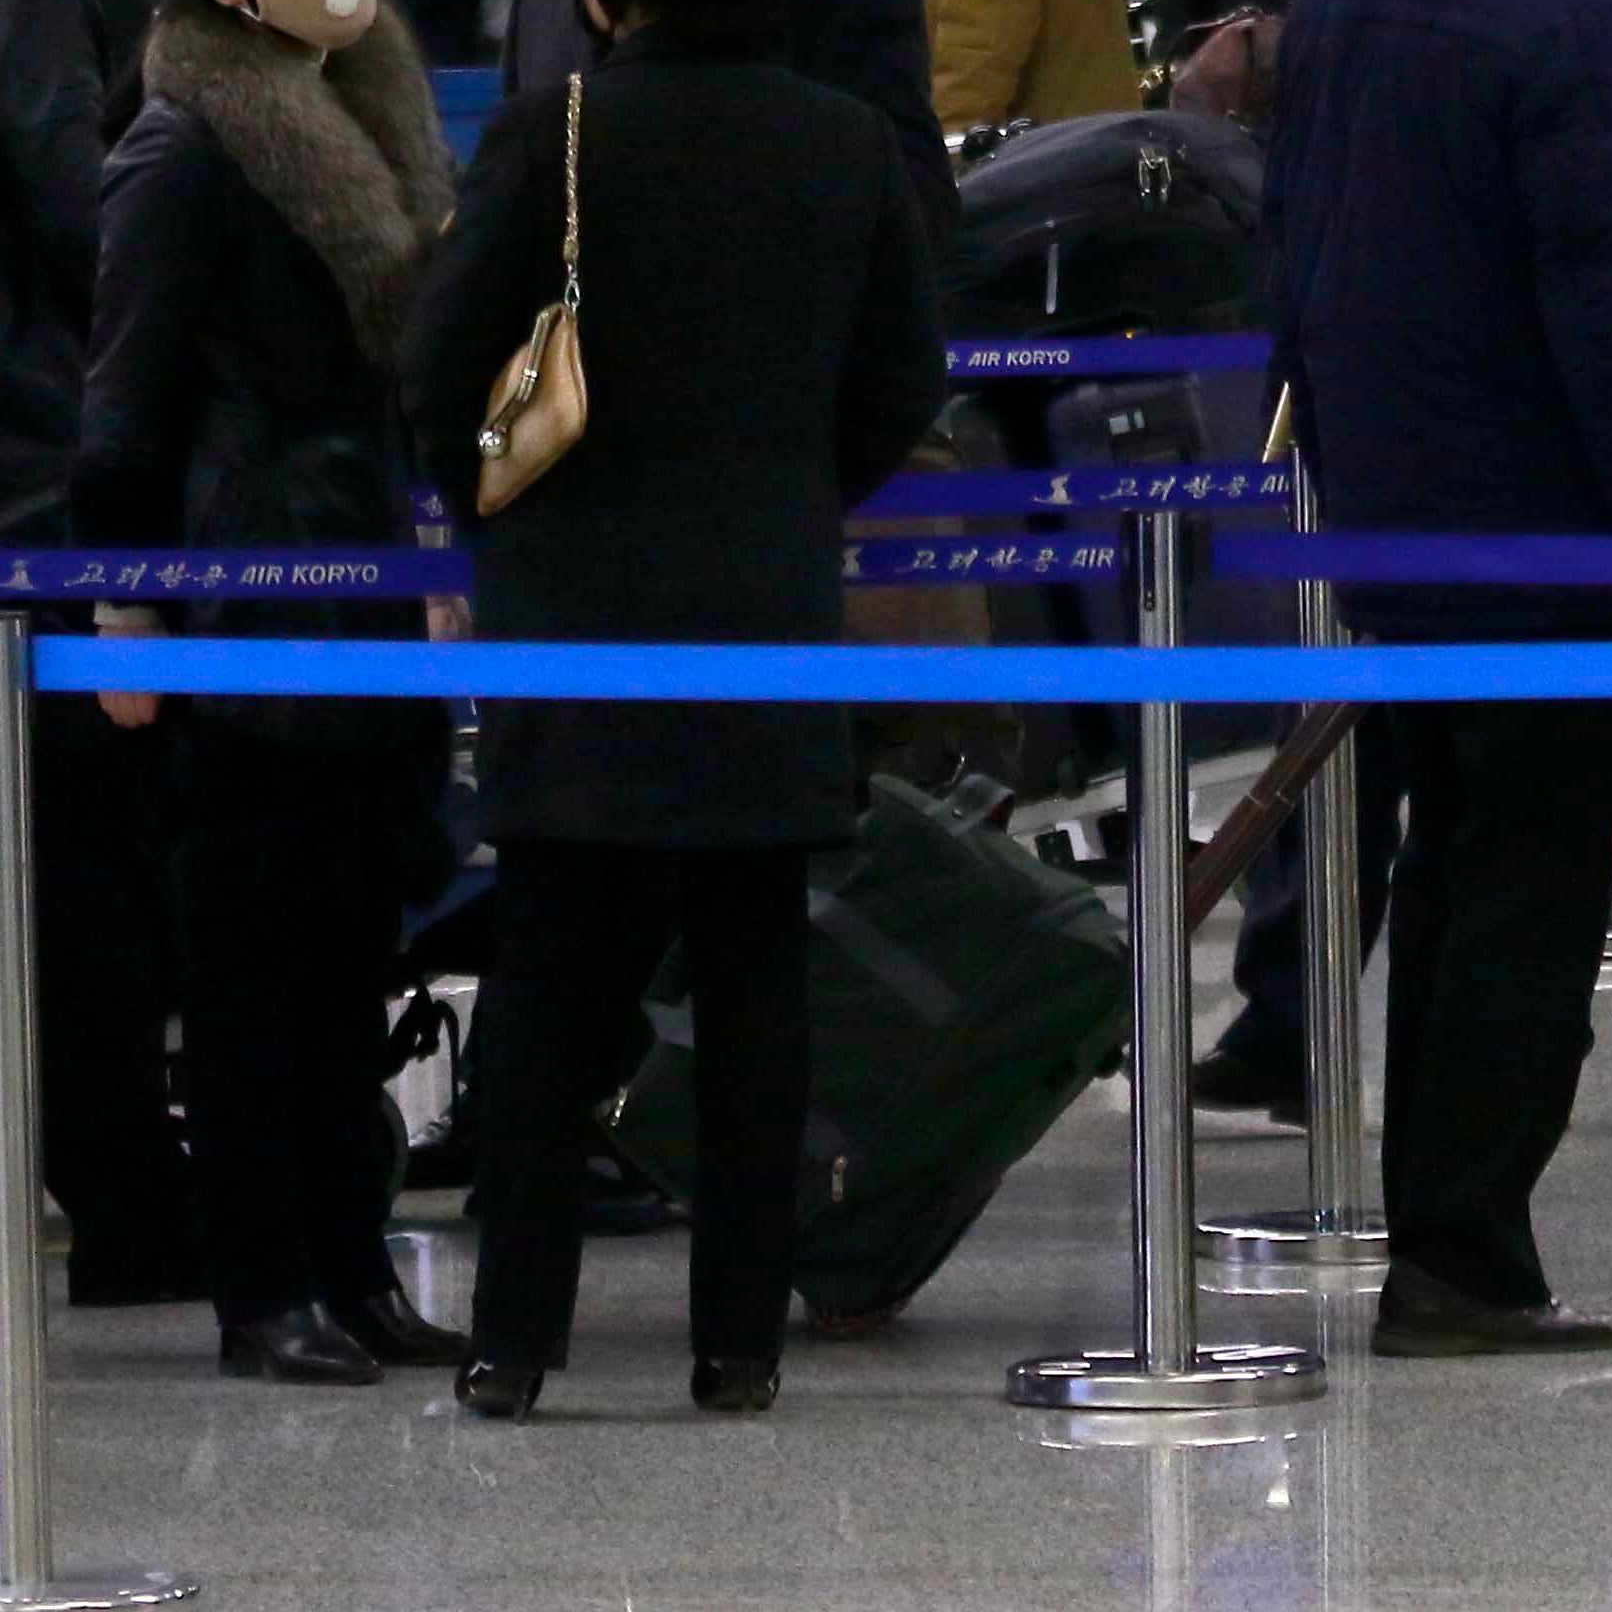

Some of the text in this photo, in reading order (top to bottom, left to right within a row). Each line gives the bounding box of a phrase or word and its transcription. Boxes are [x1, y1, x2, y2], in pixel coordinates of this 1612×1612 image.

[967, 350, 1001, 368] AIR
[1005, 349, 1071, 367] KORYO
[1069, 546, 1115, 569] AIR
[238, 564, 284, 587] AIR
[291, 563, 380, 586] KORYO
